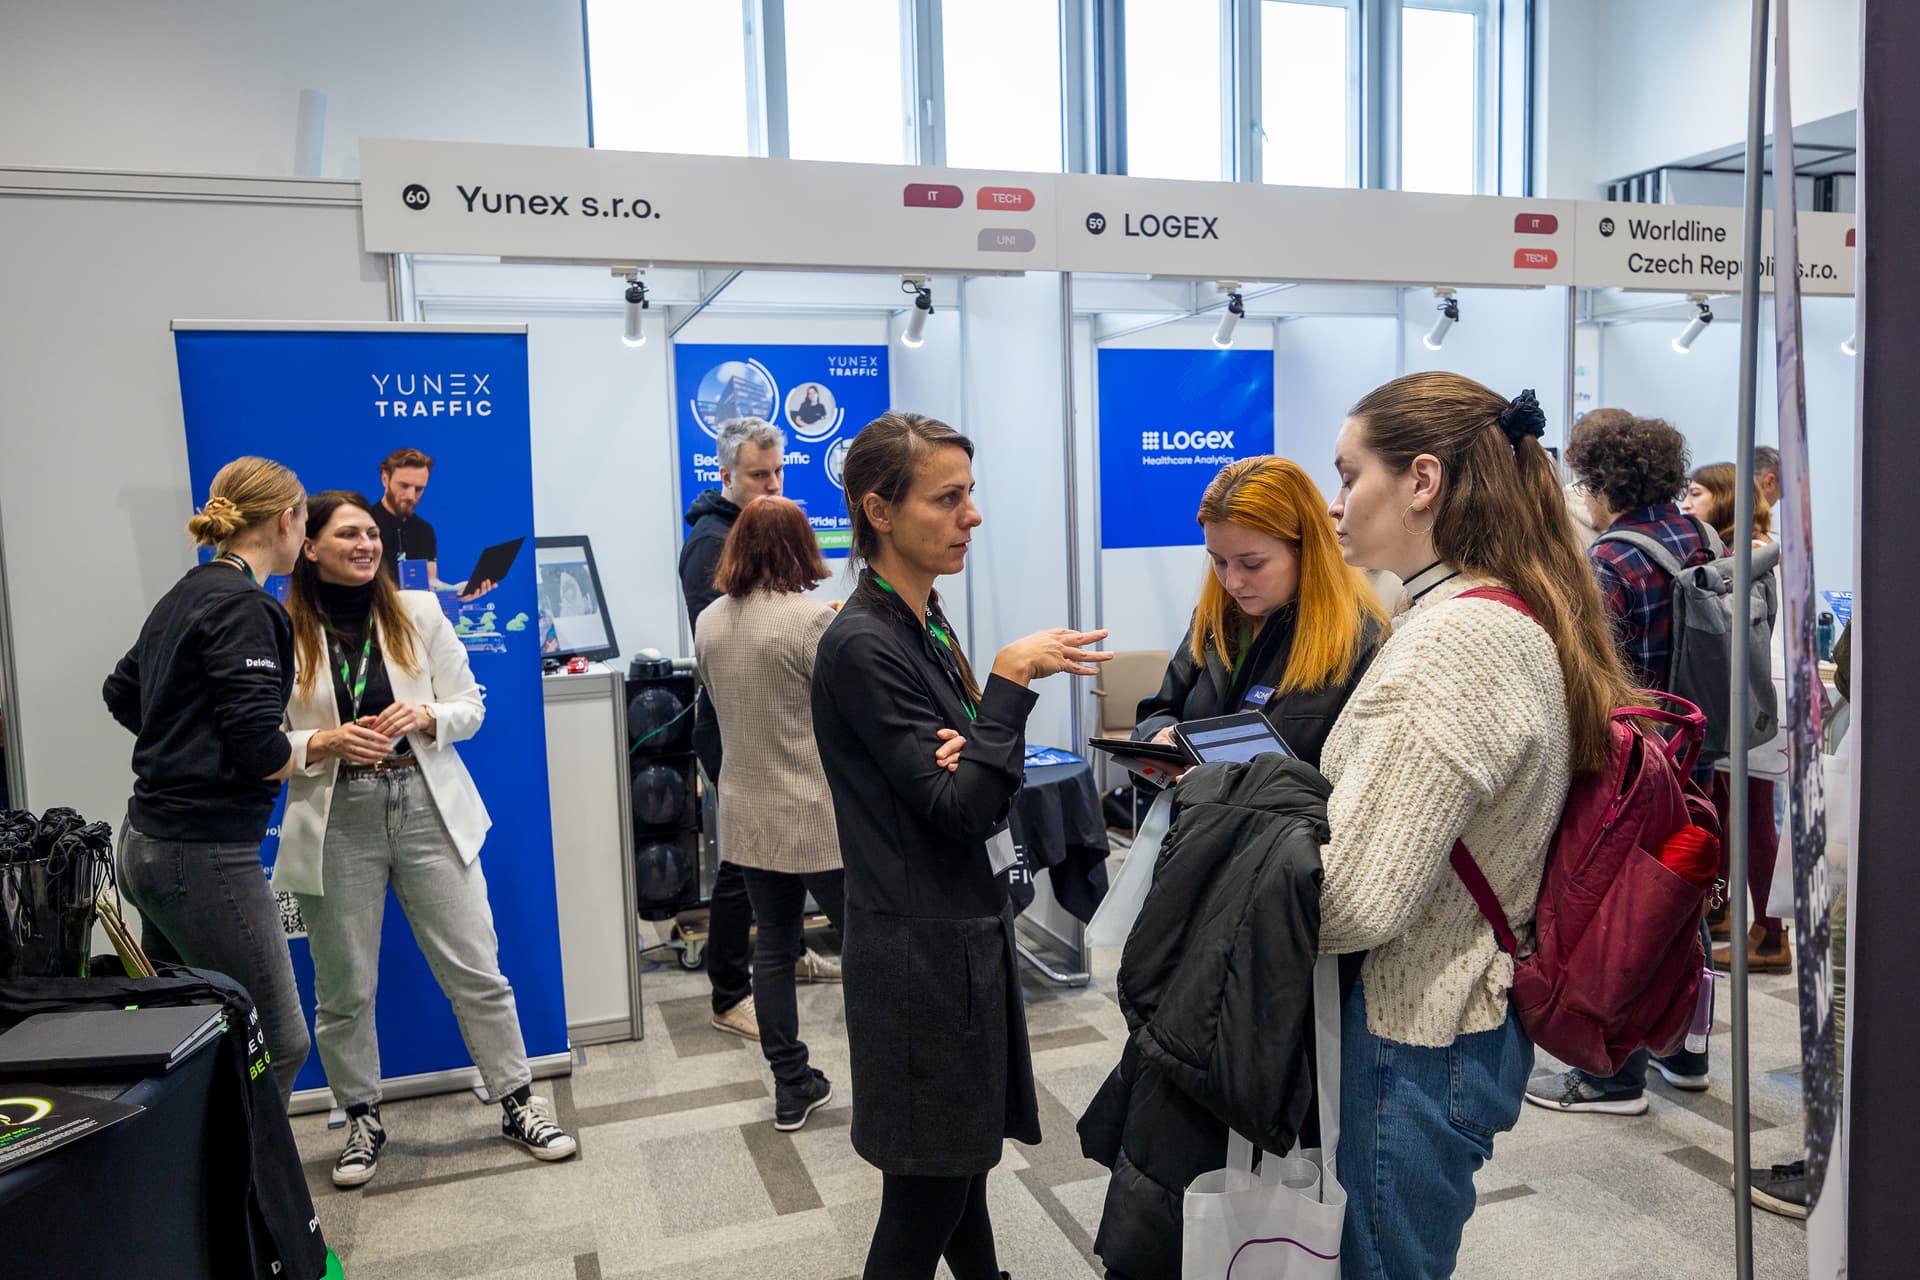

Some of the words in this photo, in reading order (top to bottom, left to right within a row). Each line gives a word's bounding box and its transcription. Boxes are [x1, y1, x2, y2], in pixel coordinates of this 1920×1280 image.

[405, 189, 428, 205] 60
[456, 185, 570, 216] Yunex
[580, 196, 662, 219] s.r.o.
[927, 190, 939, 202] IT
[991, 192, 1023, 205] TECH
[1088, 217, 1104, 230] 59
[1124, 213, 1220, 240] LOGEX
[1530, 218, 1541, 229] IT
[1628, 218, 1728, 243] Worldline
[996, 235, 1017, 246] UNI
[1524, 252, 1549, 264] TECH
[1627, 252, 1694, 275] Czech
[1700, 255, 1775, 281] Repli
[827, 355, 878, 367] YUNEX
[829, 367, 879, 377] TRAFFIC
[371, 373, 491, 396] YUNEX
[375, 399, 492, 418] TRAFFIC
[783, 451, 811, 465] affic
[1142, 455, 1194, 465] Healthcare
[1194, 454, 1235, 466] Analytics
